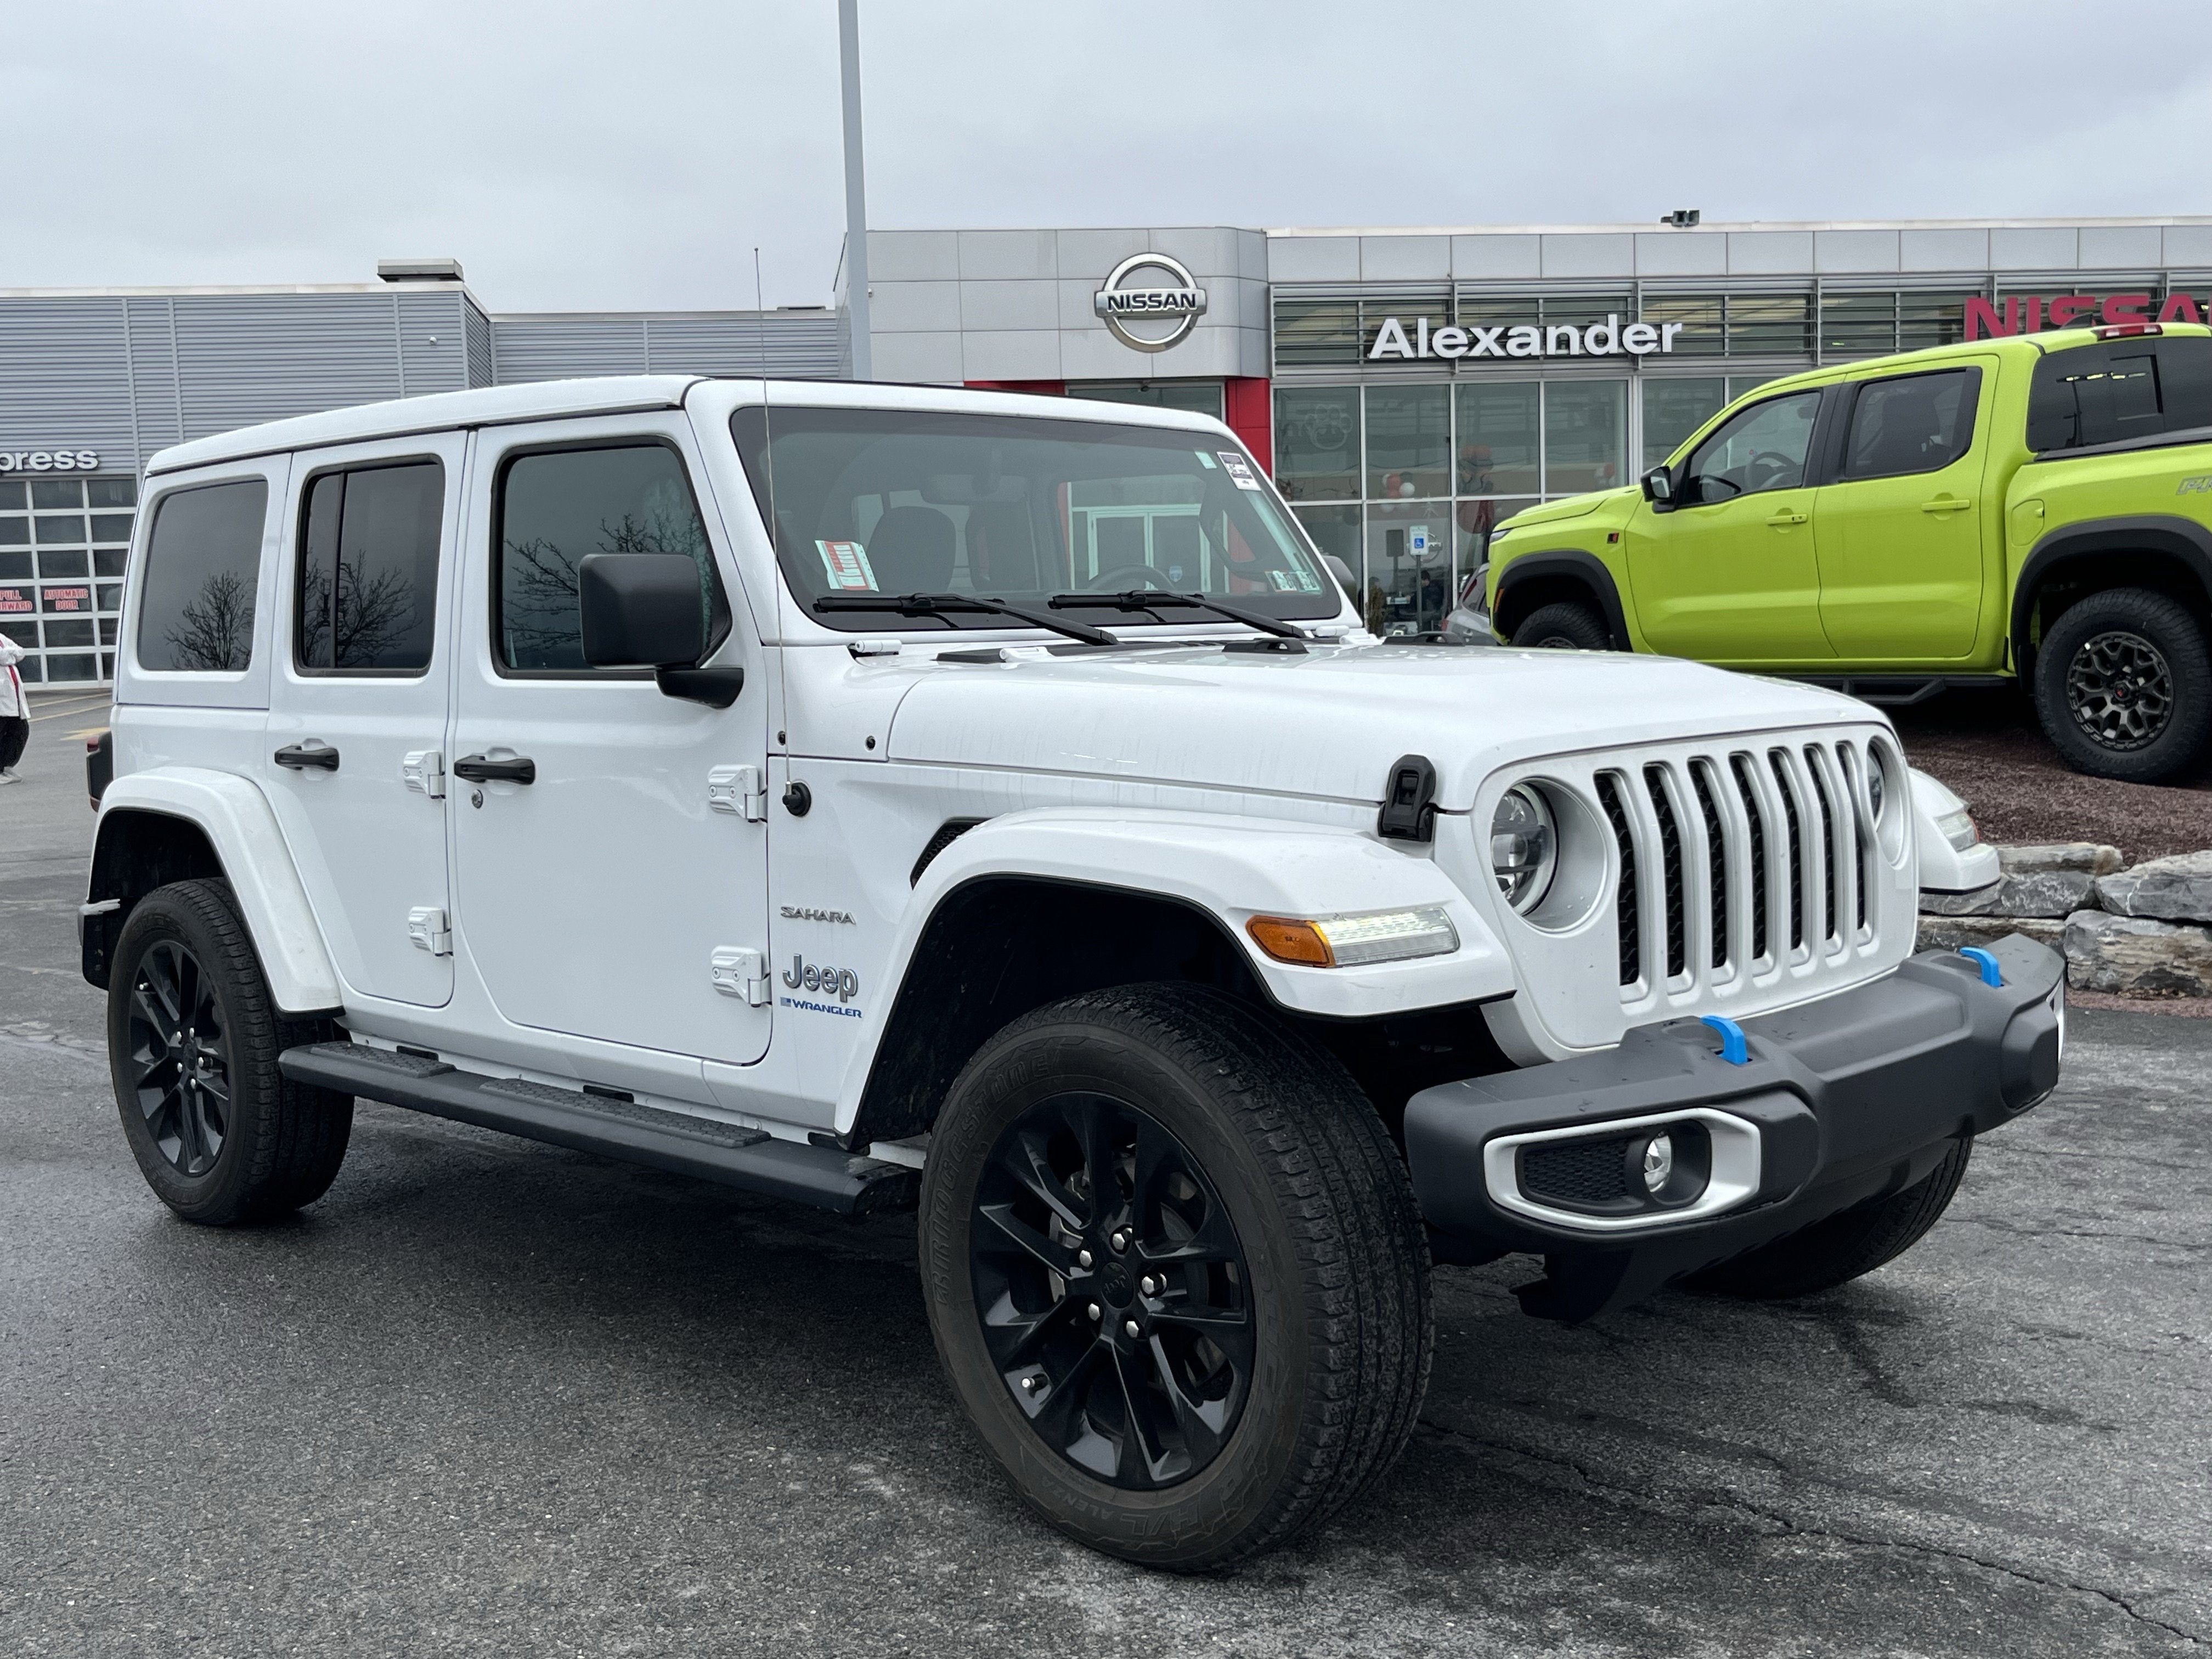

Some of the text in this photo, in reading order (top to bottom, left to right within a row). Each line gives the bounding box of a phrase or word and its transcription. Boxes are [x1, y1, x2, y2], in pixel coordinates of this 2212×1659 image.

[1107, 293, 1197, 312] NISSAN
[1965, 294, 2212, 341] NISSA
[1370, 314, 1683, 359] Alexander
[0, 450, 98, 471] press
[0, 591, 21, 600] PULL
[44, 589, 88, 600] AUTOMATIC
[56, 600, 78, 610] DOOR
[780, 906, 856, 925] SAHARA
[782, 953, 859, 1003] Jeep
[792, 998, 862, 1018] WRANGLER
[1041, 1476, 1115, 1521] ALENZA
